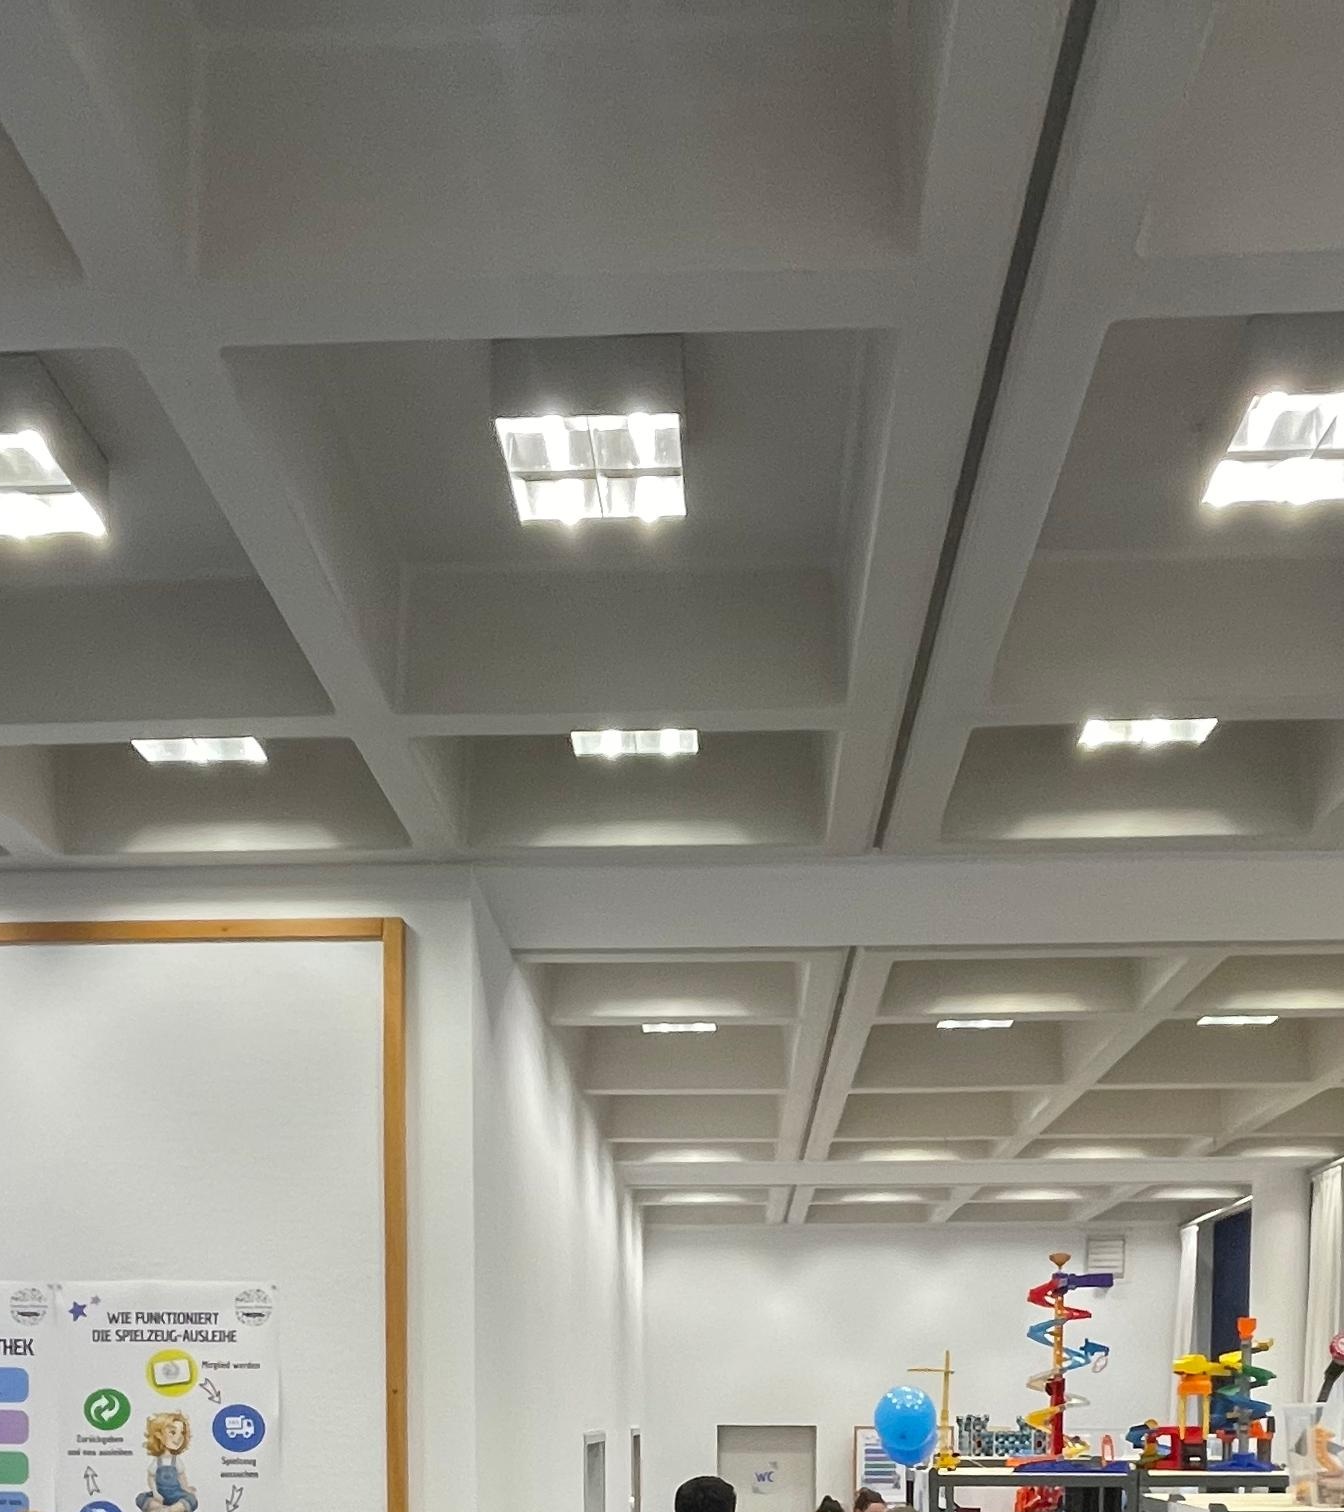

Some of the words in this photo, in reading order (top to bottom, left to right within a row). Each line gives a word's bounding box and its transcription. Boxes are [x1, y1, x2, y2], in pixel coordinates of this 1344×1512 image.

[107, 1312, 131, 1325] WIE
[135, 1312, 219, 1325] FUNKTIONIERT
[92, 1330, 112, 1343] DIE
[116, 1330, 237, 1343] SPIELZEUG-AUSLEIHE
[754, 1471, 775, 1483] WC
